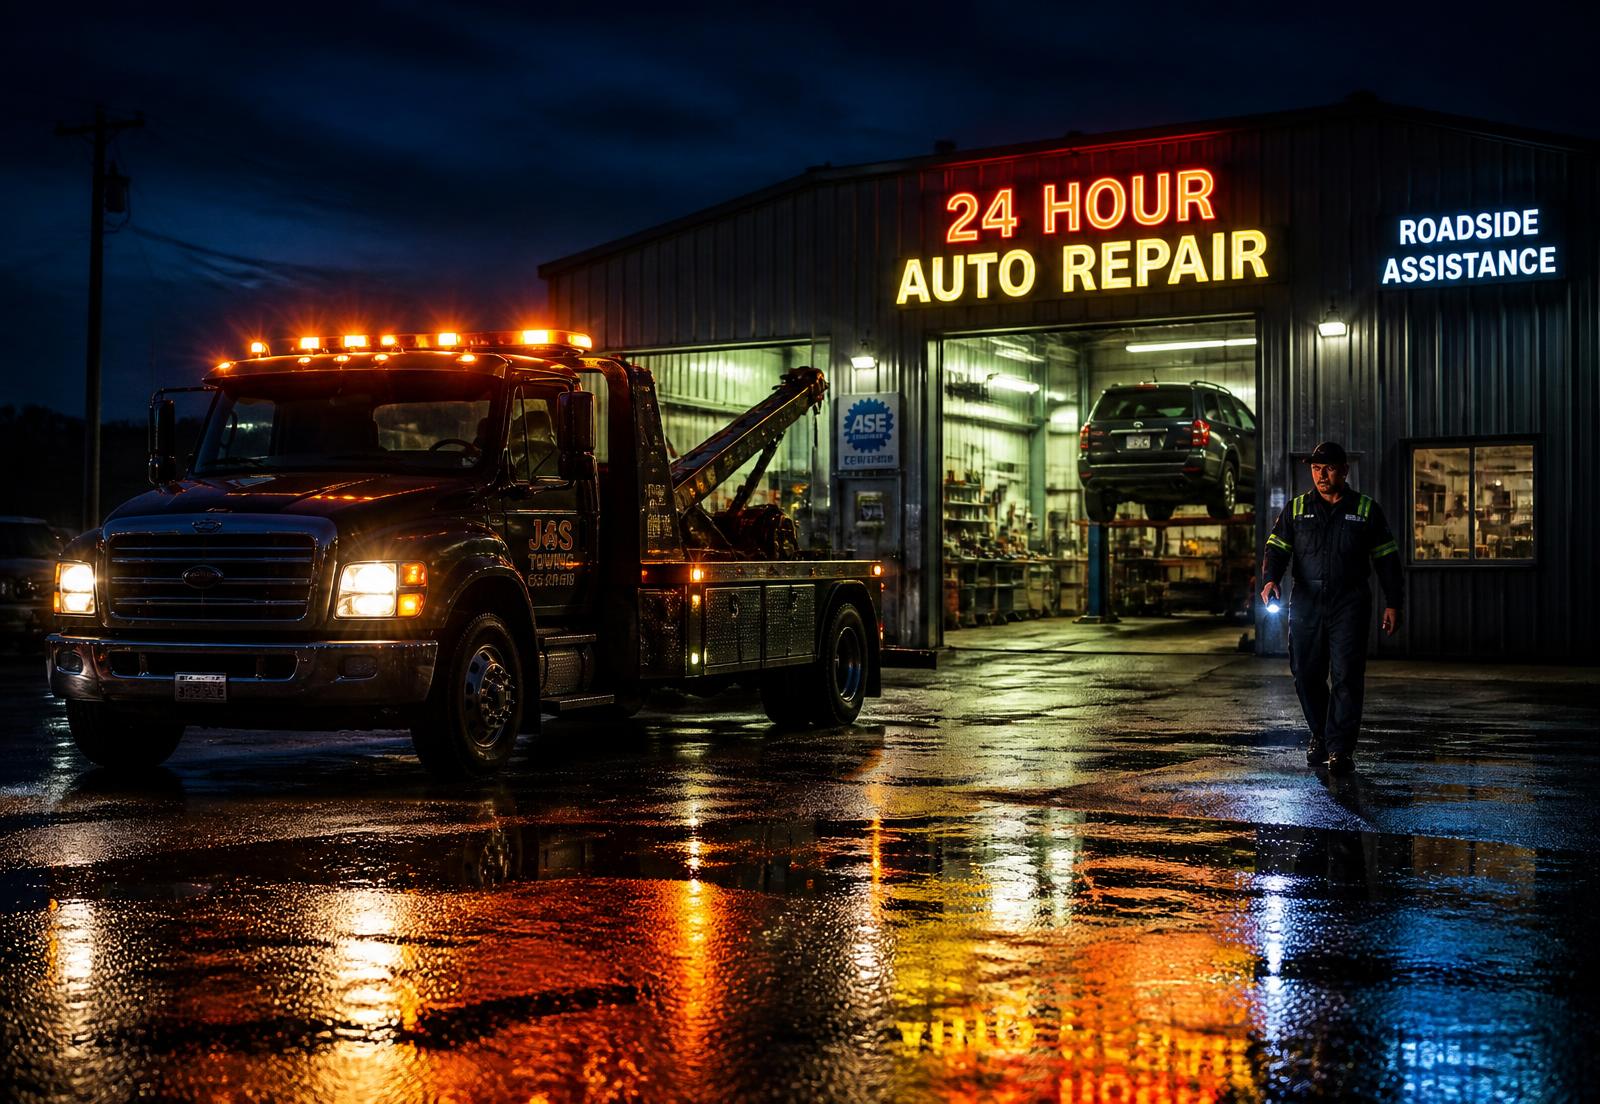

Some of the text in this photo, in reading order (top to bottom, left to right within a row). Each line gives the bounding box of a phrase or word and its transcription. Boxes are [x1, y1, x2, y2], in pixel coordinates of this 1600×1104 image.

[945, 168, 1216, 243] 24 HOUR
[1399, 208, 1539, 246] ROADSIDE
[896, 228, 1269, 305] AUTO REPAIR
[1382, 246, 1557, 285] ASSISTANCE
[850, 413, 886, 434] ASE
